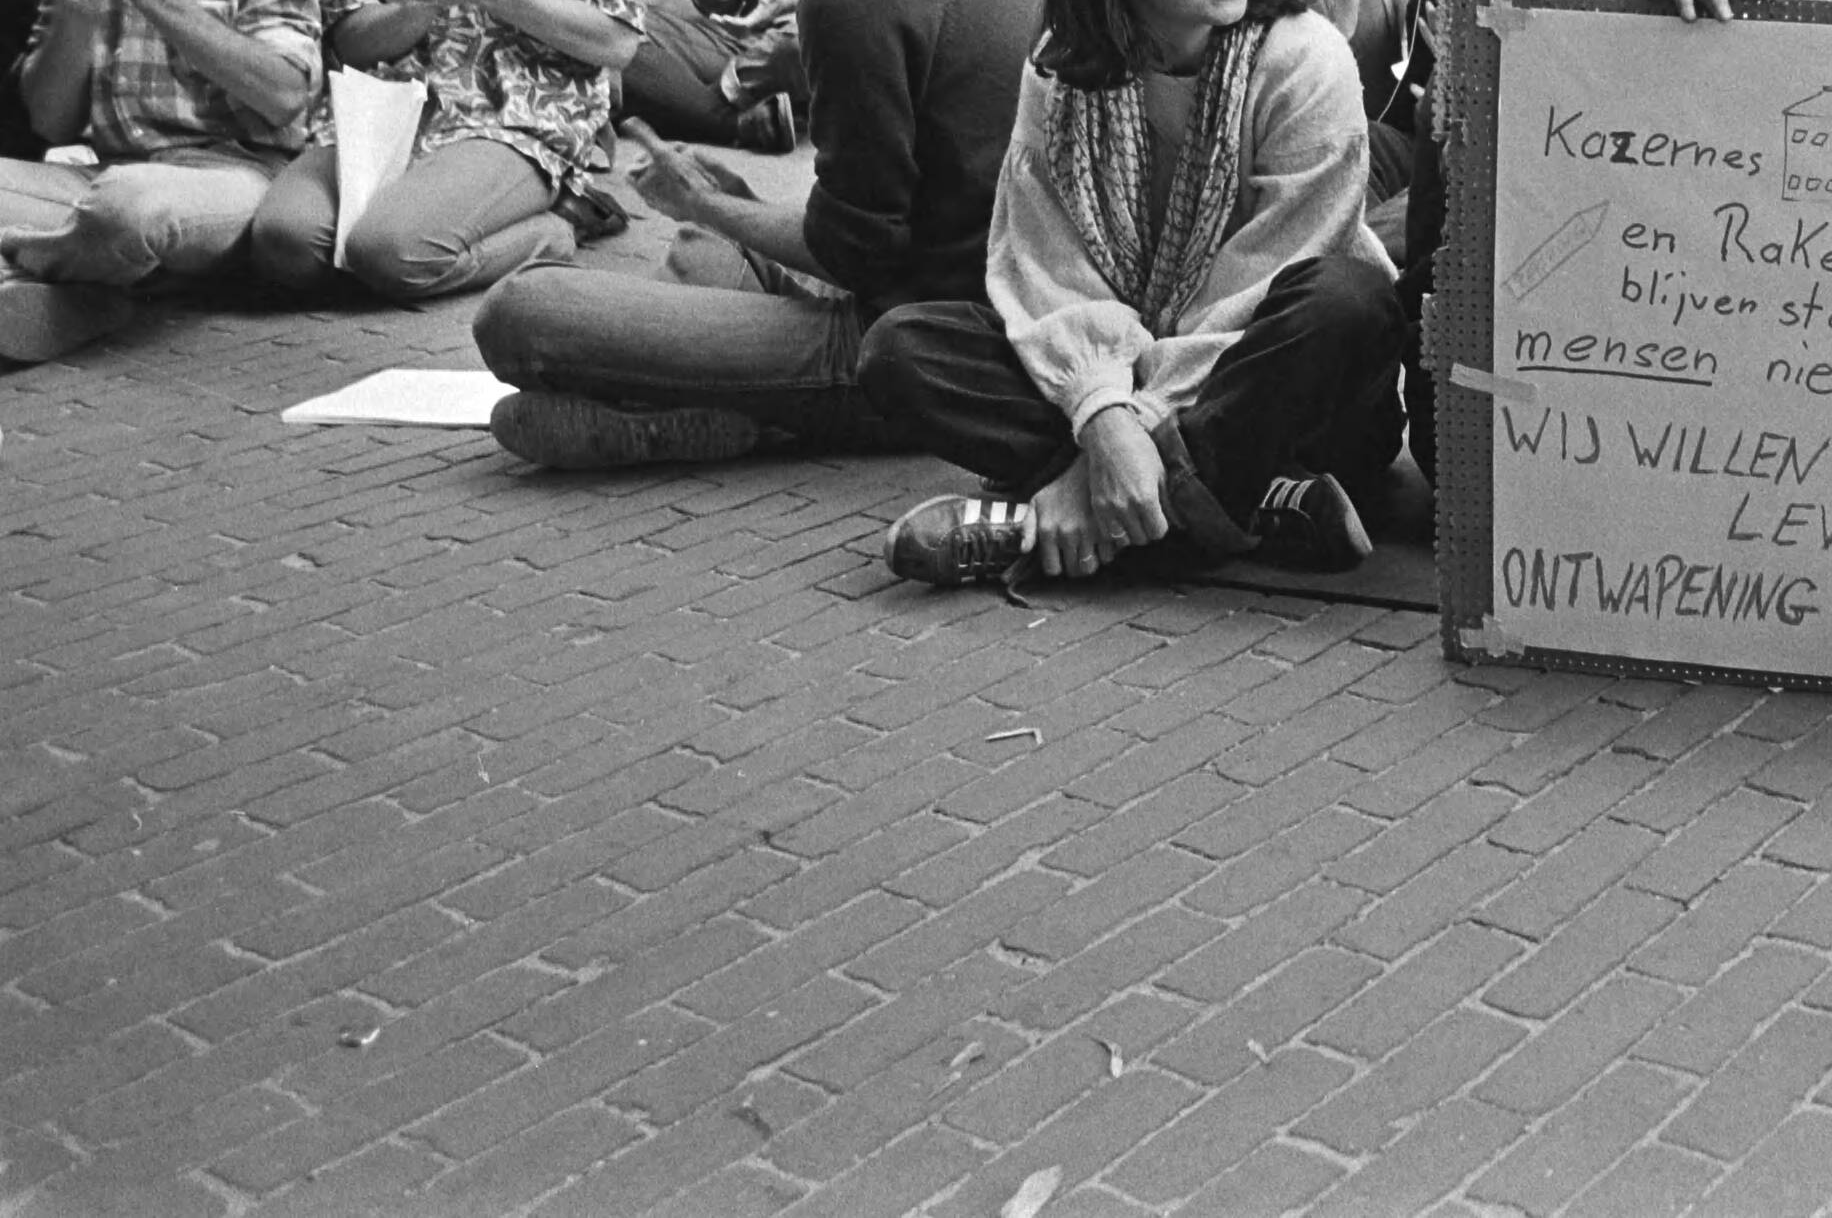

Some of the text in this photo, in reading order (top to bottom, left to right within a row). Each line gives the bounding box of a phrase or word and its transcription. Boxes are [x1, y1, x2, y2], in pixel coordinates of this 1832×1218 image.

[1544, 104, 1763, 176] Kazernes
[1622, 221, 1677, 254] en
[1621, 270, 1759, 325] blijven
[1515, 328, 1719, 376] mensen
[1502, 406, 1830, 485] WIJ WILLEN
[1502, 549, 1820, 627] ONTWAPENING
